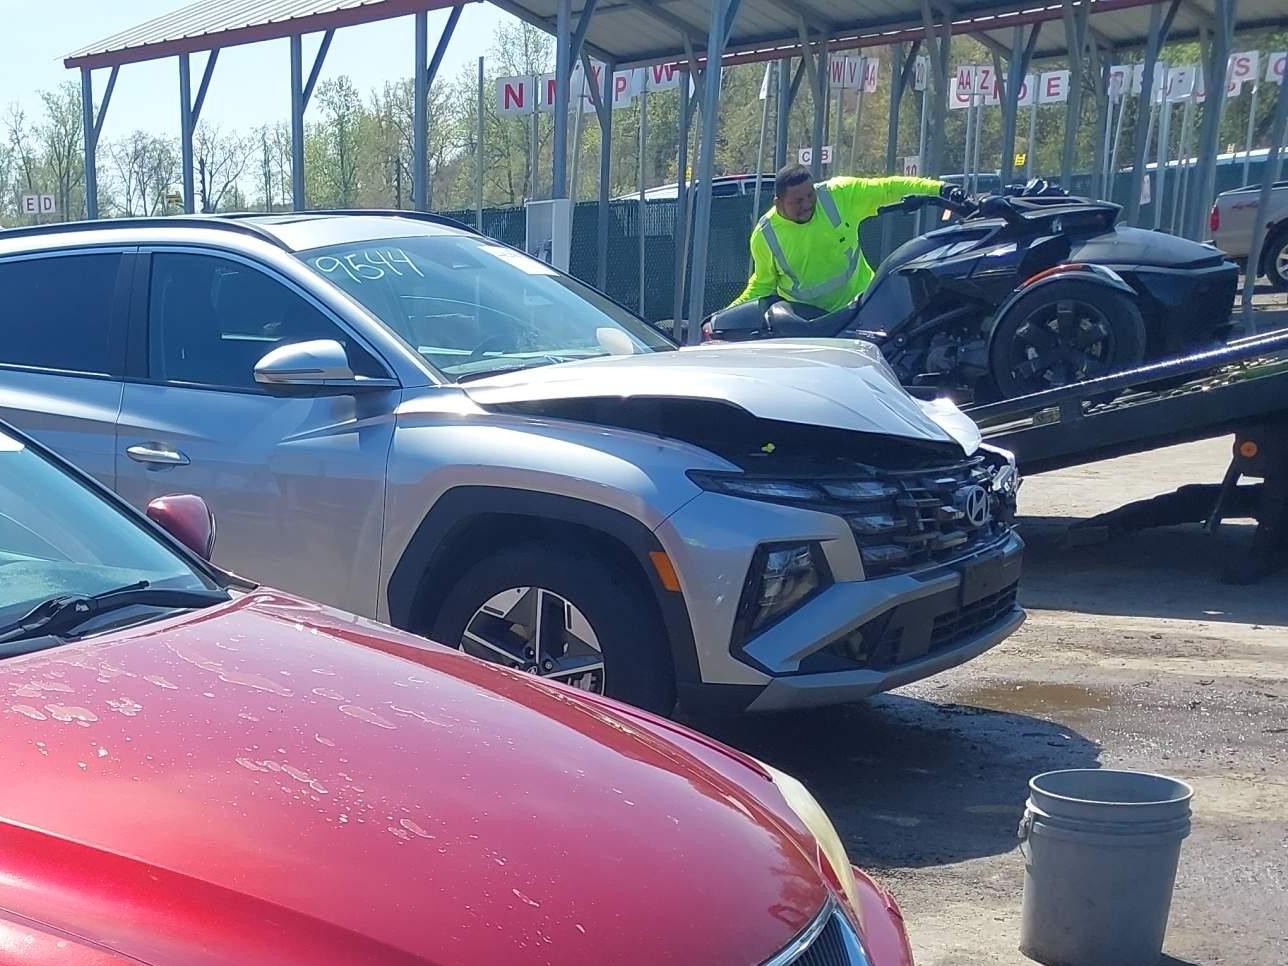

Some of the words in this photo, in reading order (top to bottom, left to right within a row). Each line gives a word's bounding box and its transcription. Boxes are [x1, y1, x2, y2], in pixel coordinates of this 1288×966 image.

[832, 61, 843, 83] W
[848, 62, 857, 84] V
[1235, 57, 1250, 76] S
[615, 76, 627, 102] P
[957, 69, 971, 90] AA
[980, 69, 990, 90] Z
[1046, 76, 1062, 97] E
[504, 82, 524, 110] N
[801, 151, 811, 163] C
[26, 197, 35, 211] E
[43, 196, 53, 211] D
[315, 248, 425, 284] 9544
